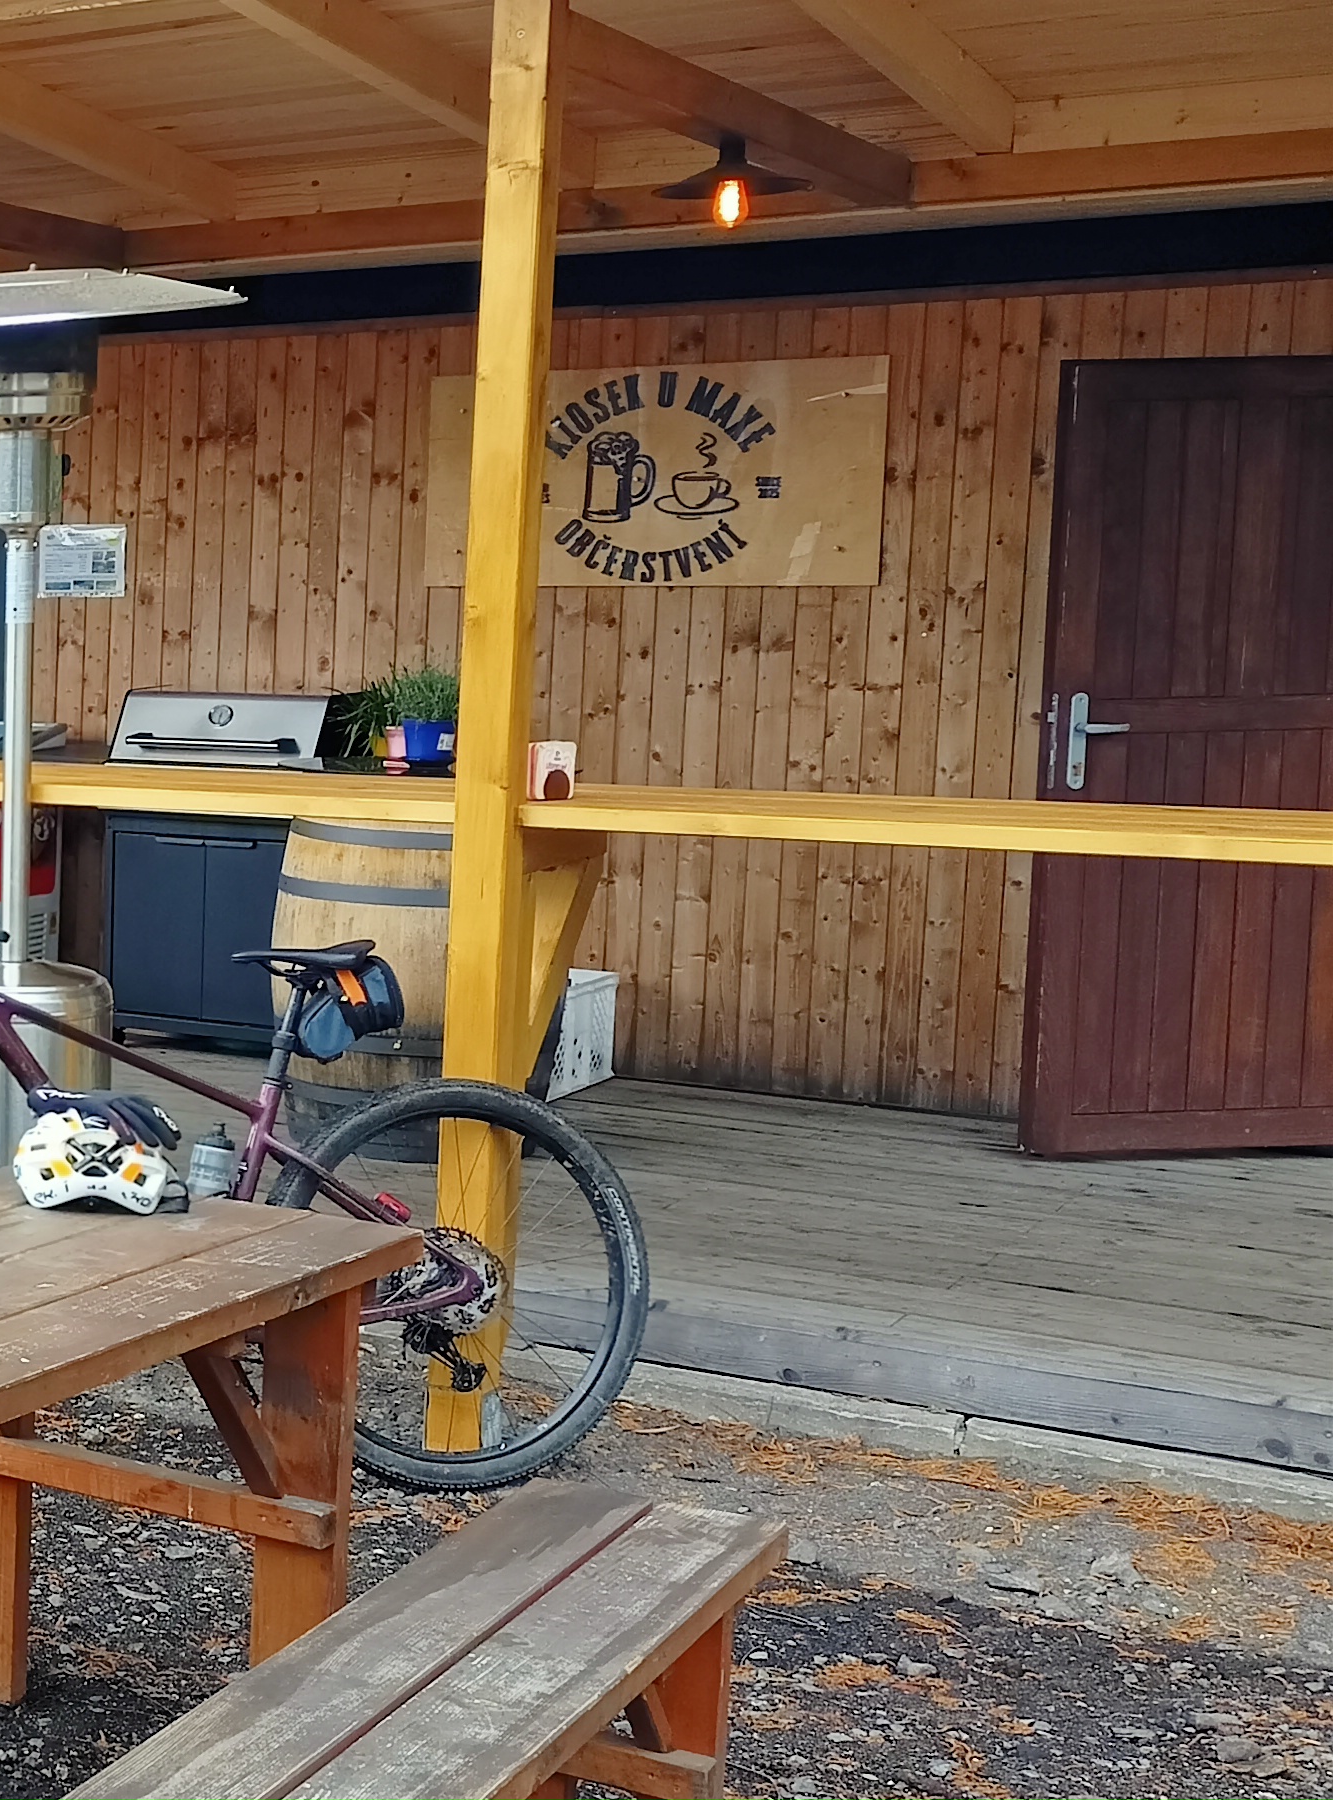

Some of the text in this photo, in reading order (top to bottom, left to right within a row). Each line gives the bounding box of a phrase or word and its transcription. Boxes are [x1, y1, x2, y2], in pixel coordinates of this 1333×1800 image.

[545, 374, 645, 460] KIOSEK
[658, 372, 678, 408] U
[555, 519, 747, 582] OBČERSTVENÍ
[608, 1187, 641, 1296] CONTINENTAL
